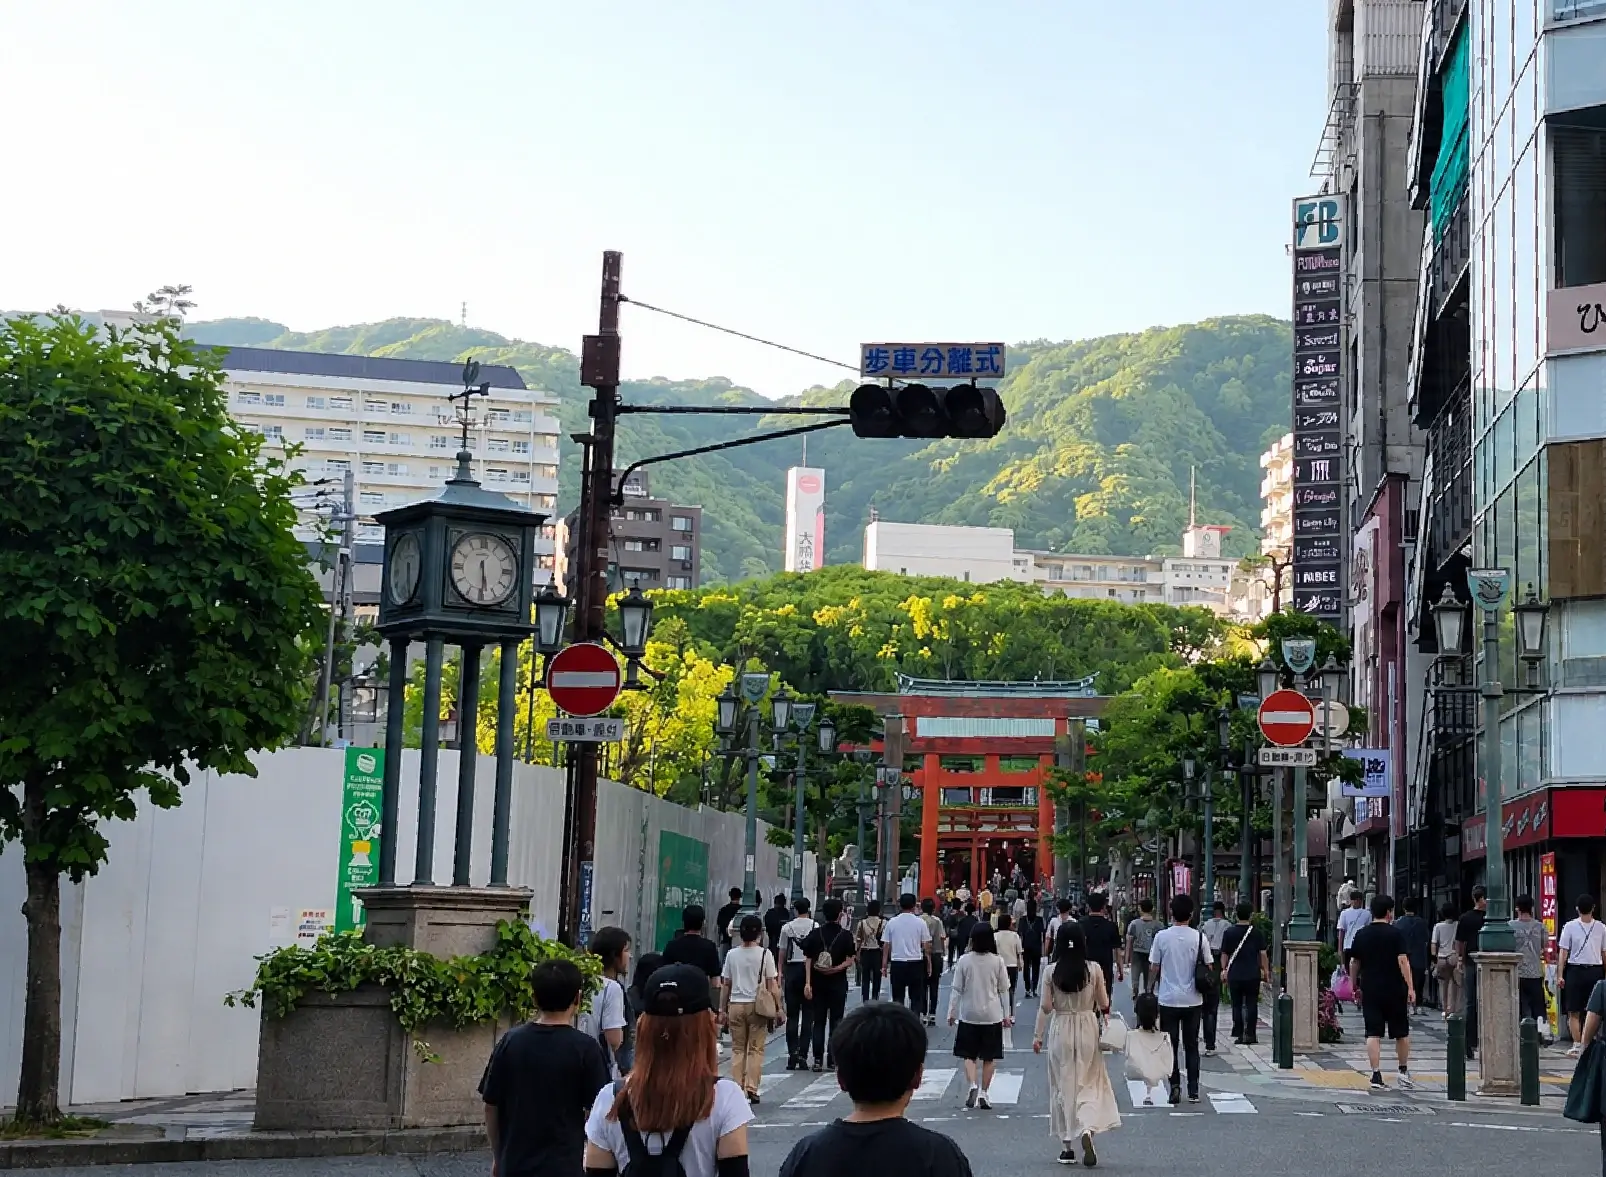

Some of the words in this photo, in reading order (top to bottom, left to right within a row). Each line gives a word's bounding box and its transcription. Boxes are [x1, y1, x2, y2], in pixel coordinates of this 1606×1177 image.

[865, 347, 1000, 374] 歩車分離式
